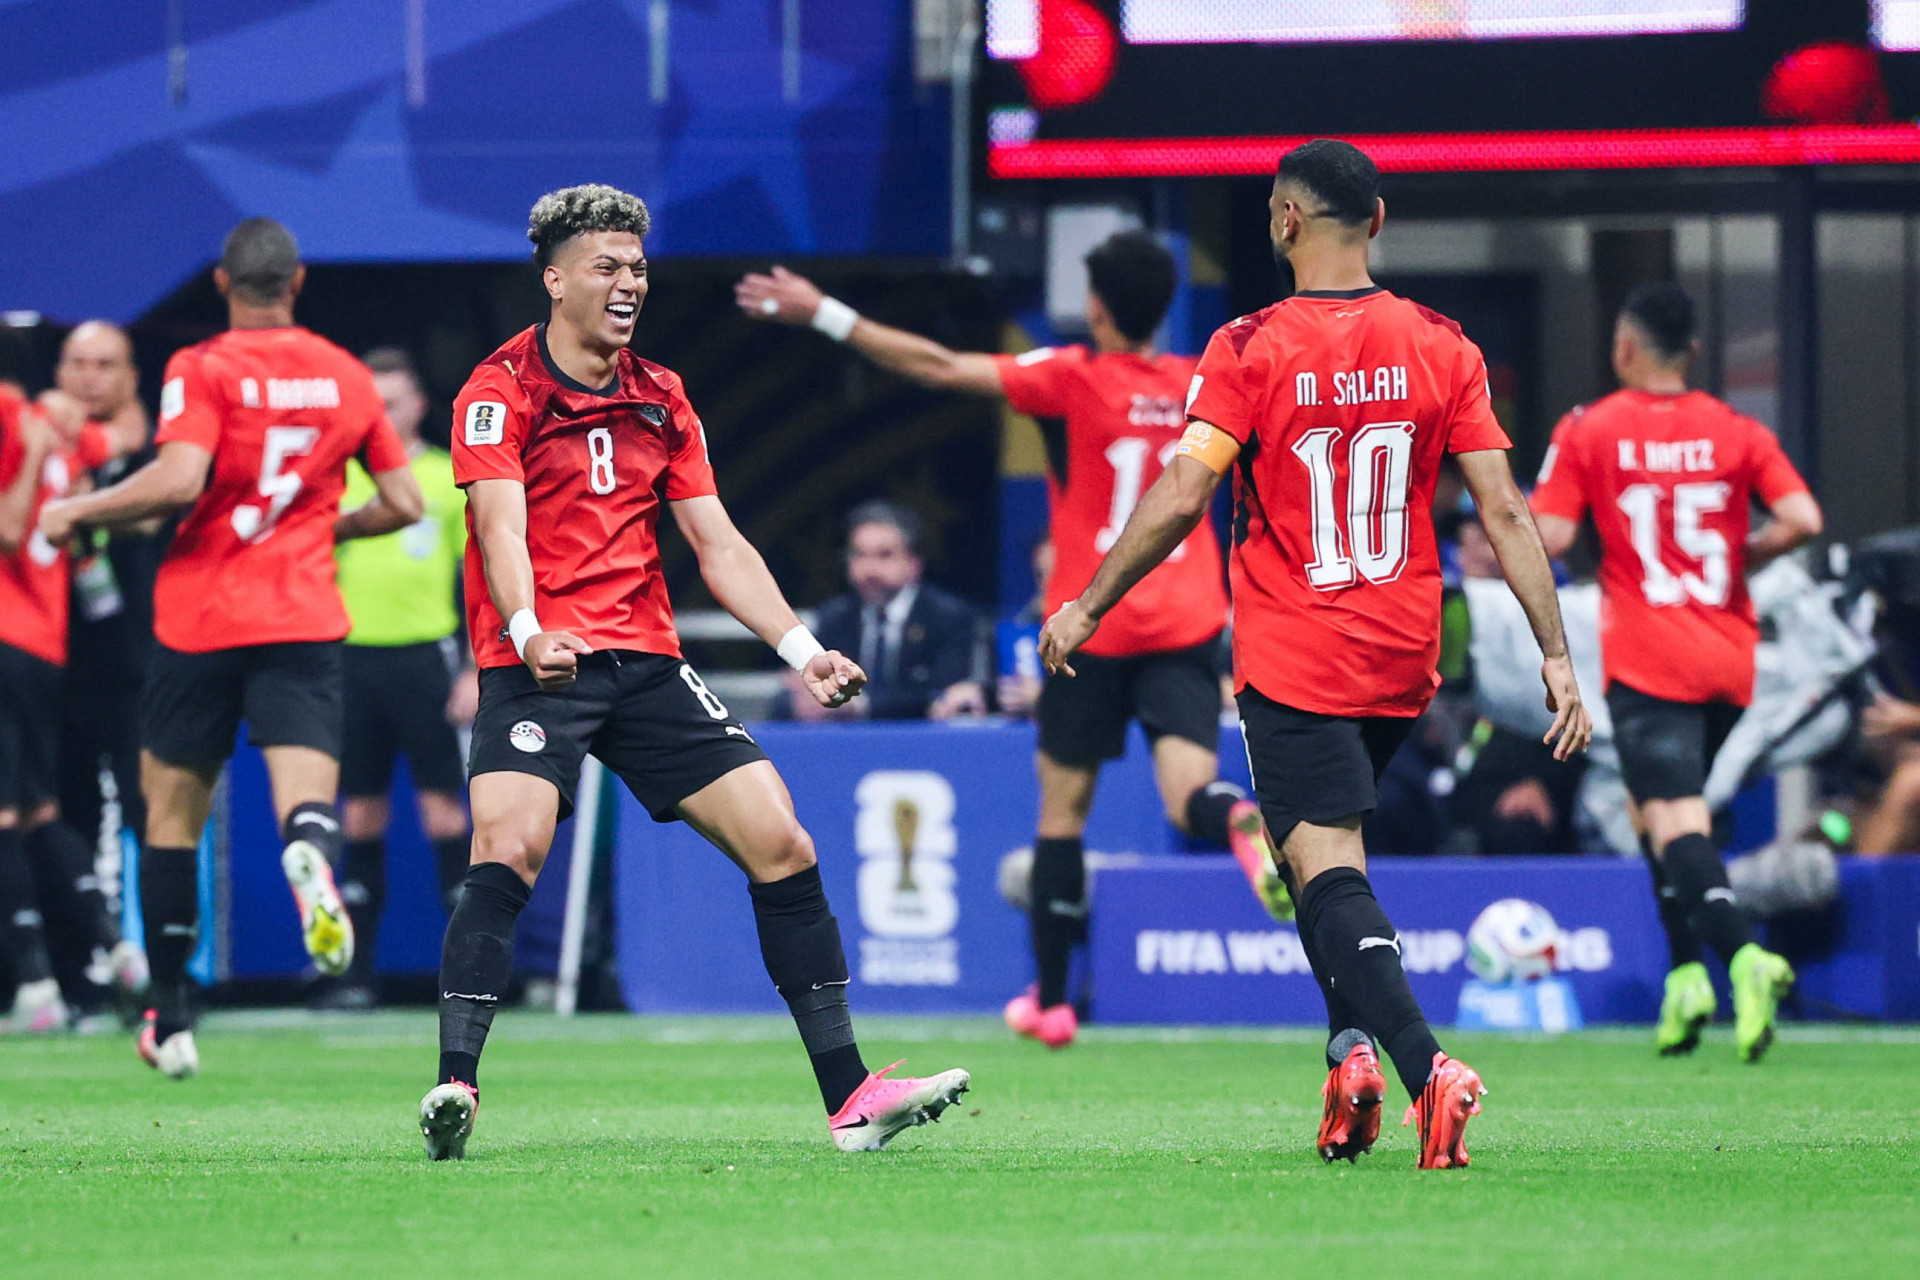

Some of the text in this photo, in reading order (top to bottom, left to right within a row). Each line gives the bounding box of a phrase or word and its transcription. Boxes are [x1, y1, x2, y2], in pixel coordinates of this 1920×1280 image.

[1295, 366, 1408, 406] M. SALAH
[231, 425, 322, 545] 5
[587, 428, 617, 495] 8
[1291, 420, 1417, 592] 10
[1617, 480, 1733, 607] 15
[680, 664, 728, 720] 8
[1136, 930, 1227, 974] FIFA
[1396, 930, 1464, 974] UP
